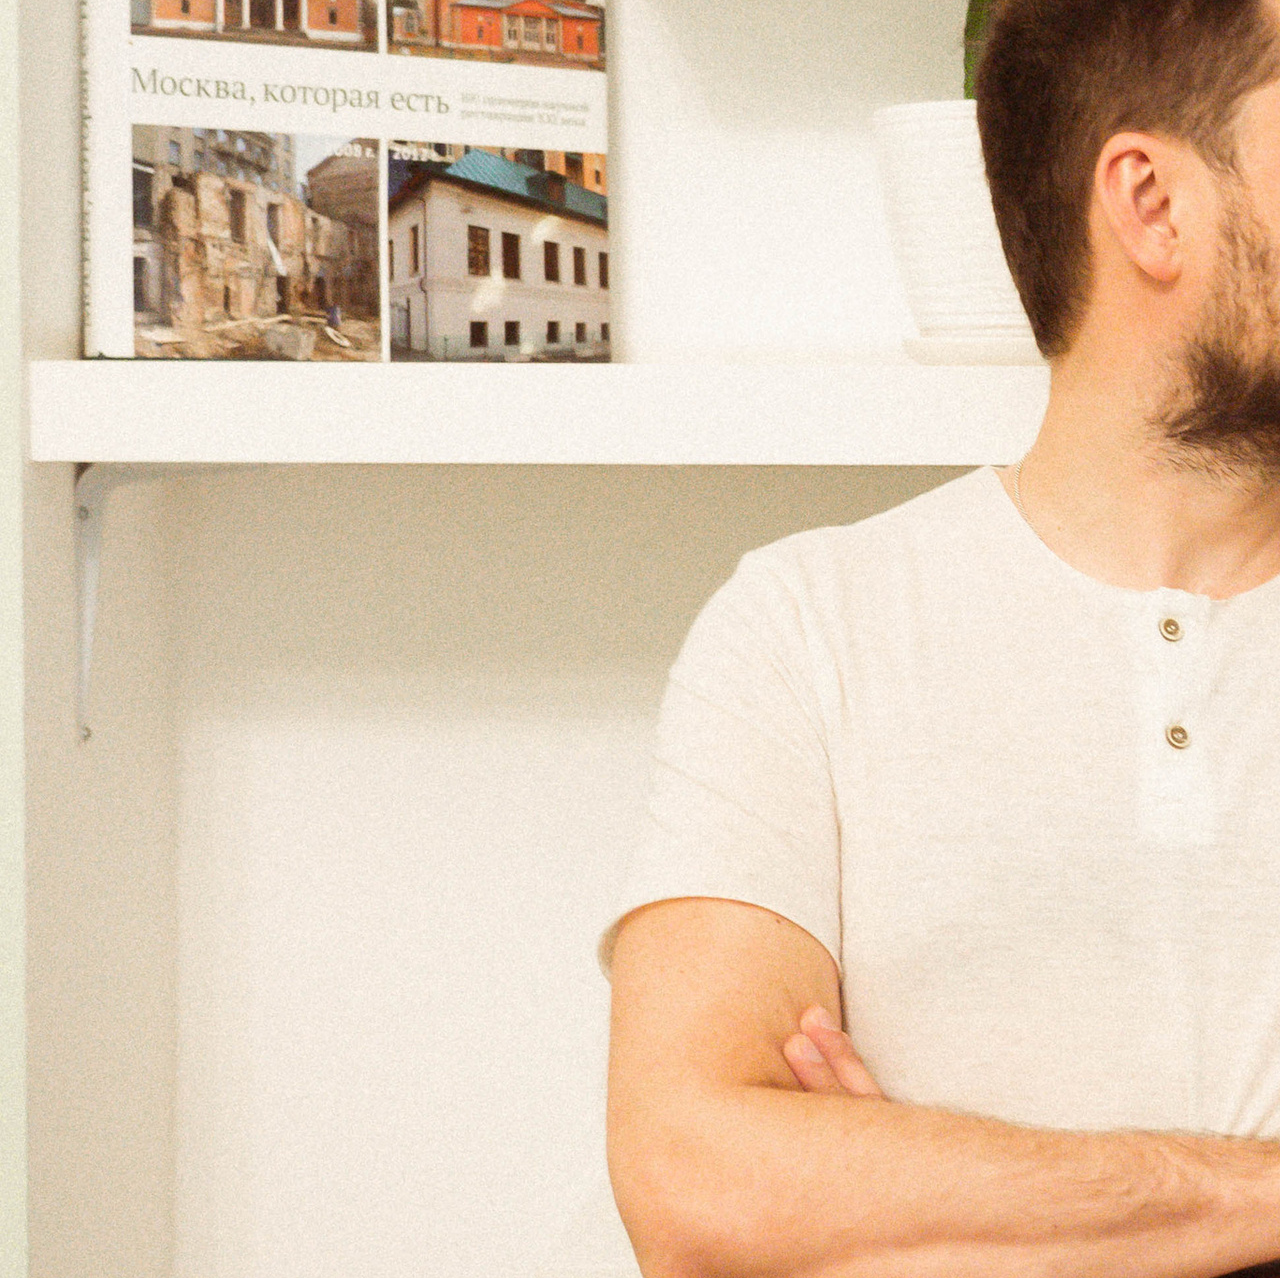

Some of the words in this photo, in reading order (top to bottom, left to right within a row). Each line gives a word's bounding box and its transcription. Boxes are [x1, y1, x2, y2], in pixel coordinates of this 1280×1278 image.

[131, 67, 256, 106] Москва,
[263, 82, 381, 113] которая
[390, 90, 450, 115] есть
